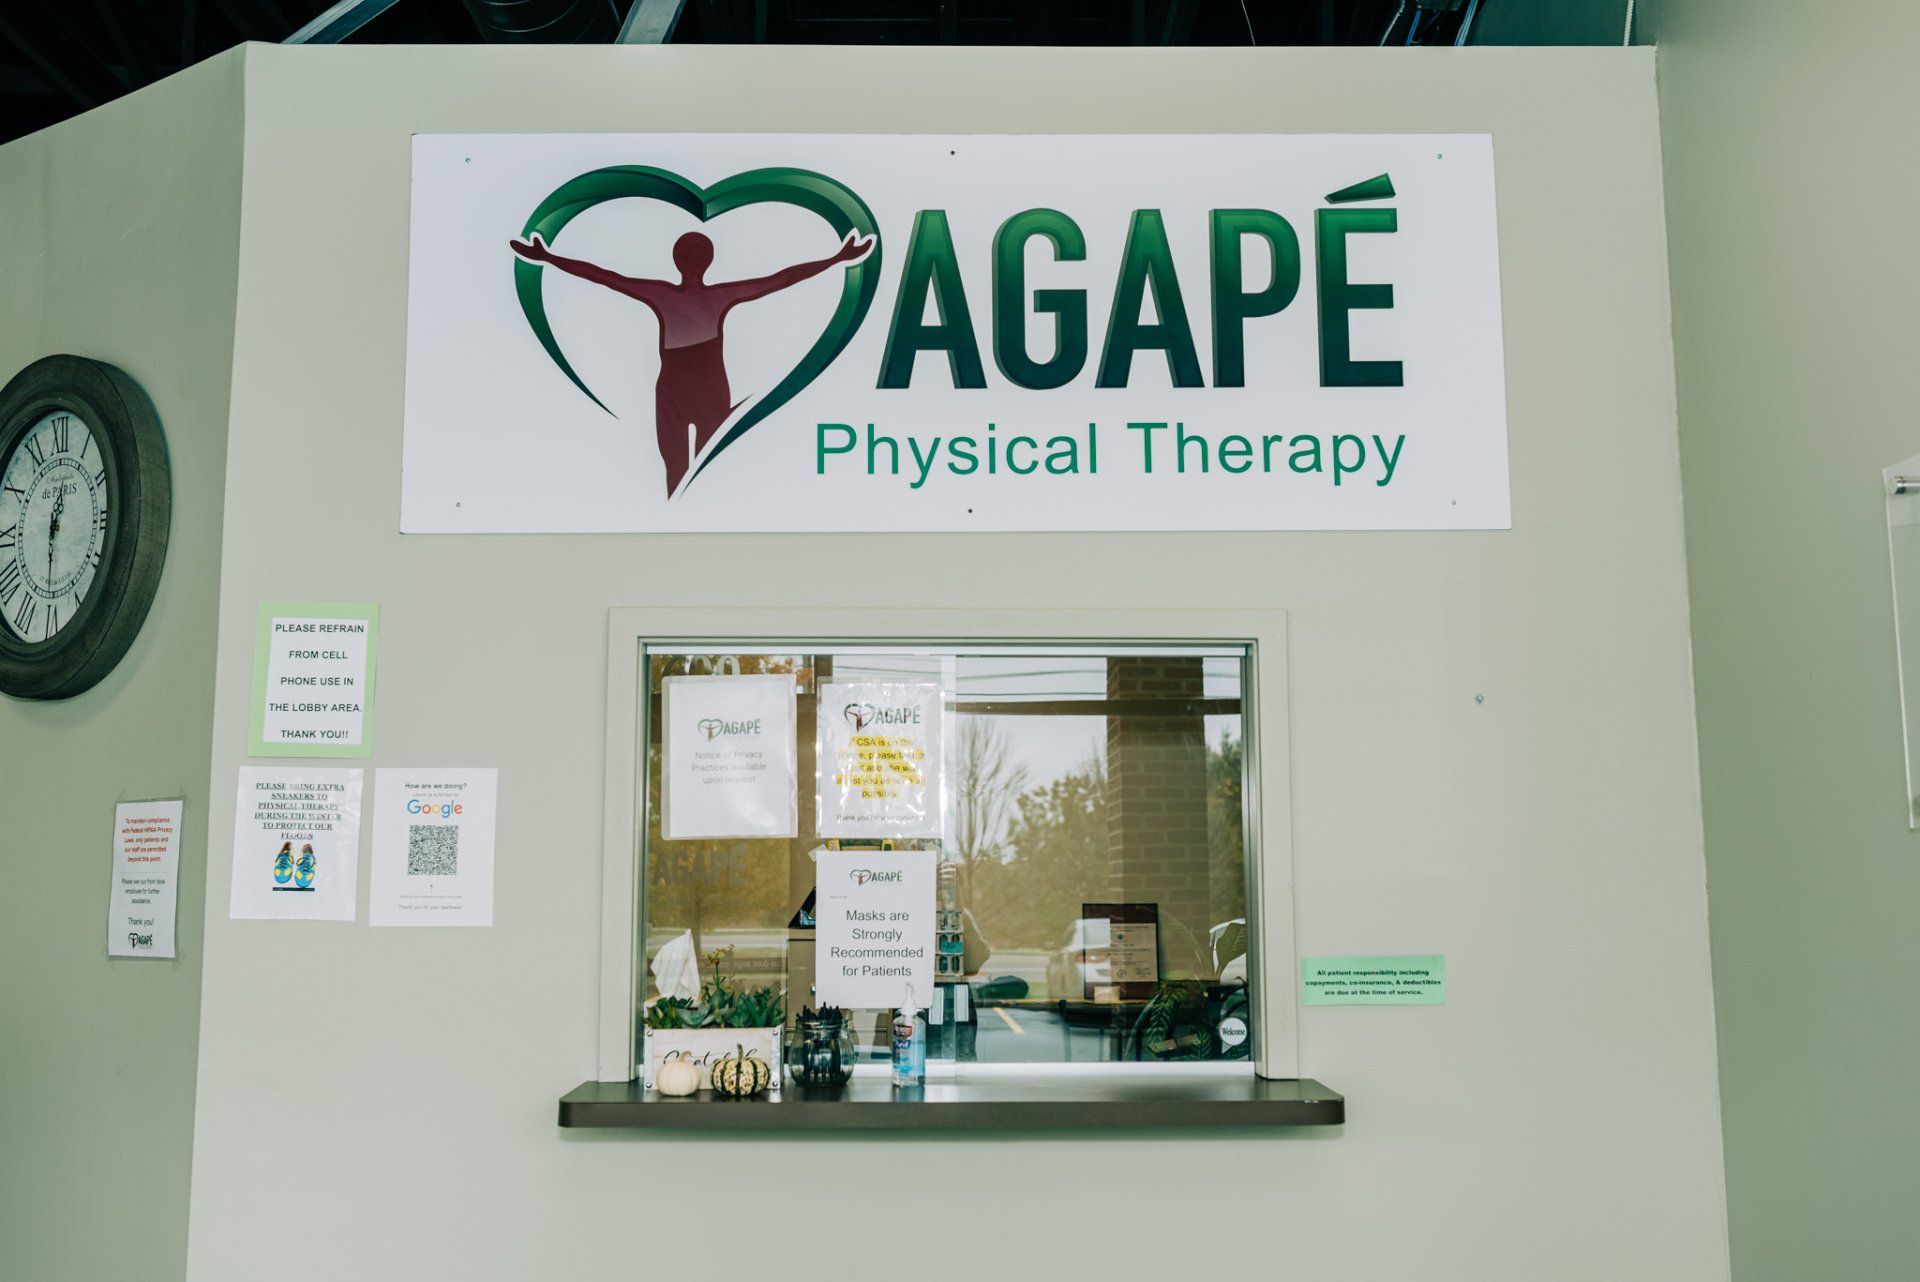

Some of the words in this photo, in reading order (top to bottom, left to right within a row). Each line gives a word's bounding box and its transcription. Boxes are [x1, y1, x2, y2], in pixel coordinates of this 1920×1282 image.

[876, 173, 1405, 389] AGAPÉ
[50, 416, 69, 456] XII
[24, 432, 46, 474] XI
[815, 422, 1098, 488] Physical
[1126, 421, 1406, 487] Therapy
[4, 477, 25, 504] X
[52, 482, 77, 498] PARIS
[275, 624, 316, 633] PLEASE
[319, 624, 364, 634] REFRAIN
[288, 650, 319, 660] FROM
[322, 651, 348, 660] CELL
[280, 676, 317, 686] PHONE
[320, 677, 341, 686] USE
[343, 677, 354, 686] IN
[269, 703, 289, 712] THE
[292, 703, 329, 712] LOBBY
[330, 703, 363, 713] AREA.
[875, 704, 921, 724] AGAPÉ
[723, 718, 762, 736] AGAPÉ
[280, 729, 317, 739] THANK
[320, 730, 349, 739] YOU!!
[856, 738, 876, 747] CSA
[878, 738, 886, 747] is
[695, 751, 722, 760] Notice
[723, 750, 732, 760] of
[734, 750, 763, 761] Privacy
[868, 751, 896, 762] pease
[691, 763, 729, 773] Practices
[731, 762, 767, 772] available
[702, 776, 724, 786] upon
[725, 775, 756, 786] request
[836, 776, 861, 785] ast
[255, 782, 287, 790] PLEASE
[317, 784, 345, 792] EXTRA
[444, 783, 468, 792] doing?
[271, 793, 315, 801] SNEAKERS
[258, 802, 298, 811] PHYSICAL
[300, 803, 340, 811] THERAPY
[407, 799, 464, 819] Google
[254, 812, 289, 820] DURING
[857, 815, 869, 824] you
[262, 822, 274, 830] TO
[275, 822, 314, 830] PROTECT
[315, 823, 333, 831] OUR
[871, 870, 903, 883] AGAPÉ
[846, 909, 886, 922] Masks
[889, 911, 910, 922] are
[128, 917, 142, 926] Thank
[143, 917, 155, 928] you!
[852, 927, 903, 943] Strongly
[830, 946, 924, 959] Recommended
[842, 964, 858, 977] for
[862, 964, 912, 977] Patients
[1353, 969, 1398, 977] responsibility
[1399, 969, 1430, 977] including
[1221, 1027, 1246, 1037] Welcome
